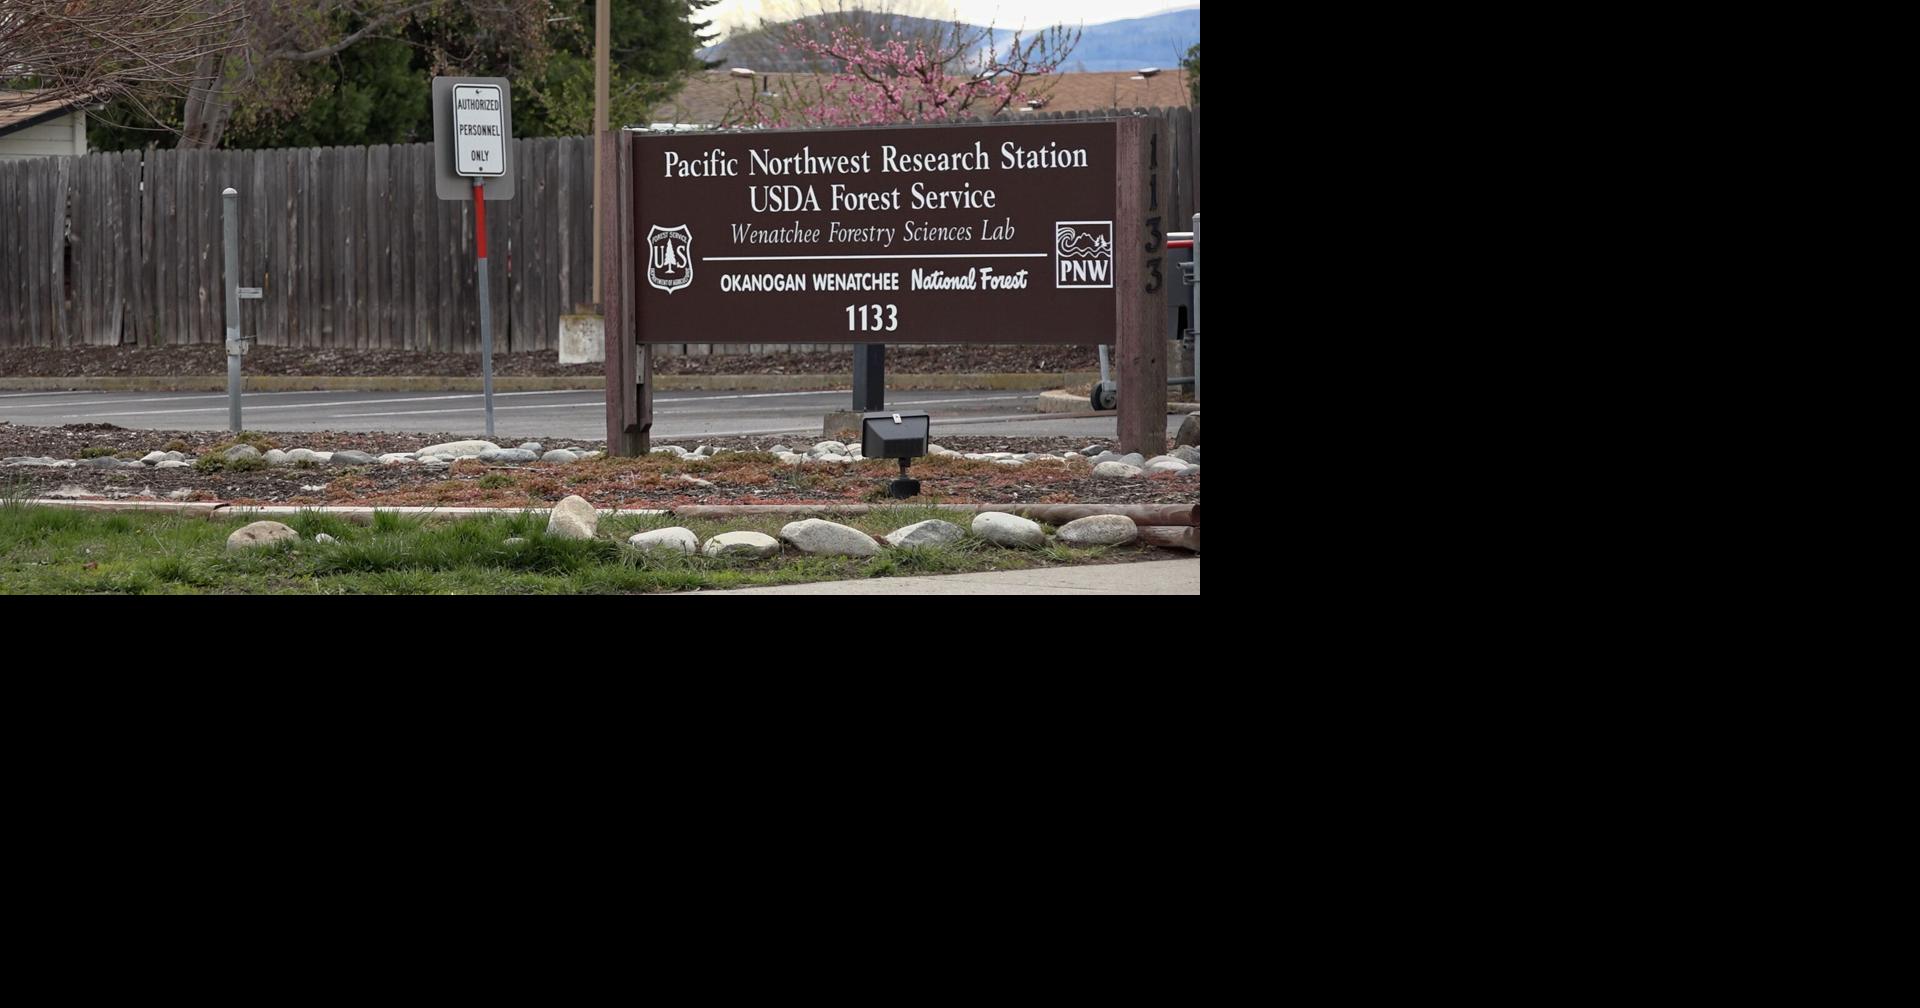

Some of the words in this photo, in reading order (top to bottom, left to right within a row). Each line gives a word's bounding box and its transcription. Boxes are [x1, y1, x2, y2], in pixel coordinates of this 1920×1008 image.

[457, 99, 500, 111] AUTHORIZED
[459, 124, 501, 137] PERSONNEL
[471, 150, 490, 161] ONLY
[664, 148, 738, 178] Pacific
[749, 145, 871, 176] Northwest
[881, 140, 990, 173] Research
[1000, 141, 1089, 170] Station
[748, 184, 821, 213] USDA
[830, 183, 901, 211] Forest
[911, 181, 996, 210] Service
[731, 220, 821, 244] Wenatchee
[828, 221, 896, 248] Forestry
[903, 220, 973, 242] Sciences
[980, 216, 1015, 241] Lab
[720, 273, 807, 293] OKANOGAN
[812, 272, 900, 292] WENATCHEE
[911, 267, 977, 292] National
[979, 266, 1029, 291] Forest
[1060, 260, 1108, 282] PNW
[845, 303, 898, 332] 1133
